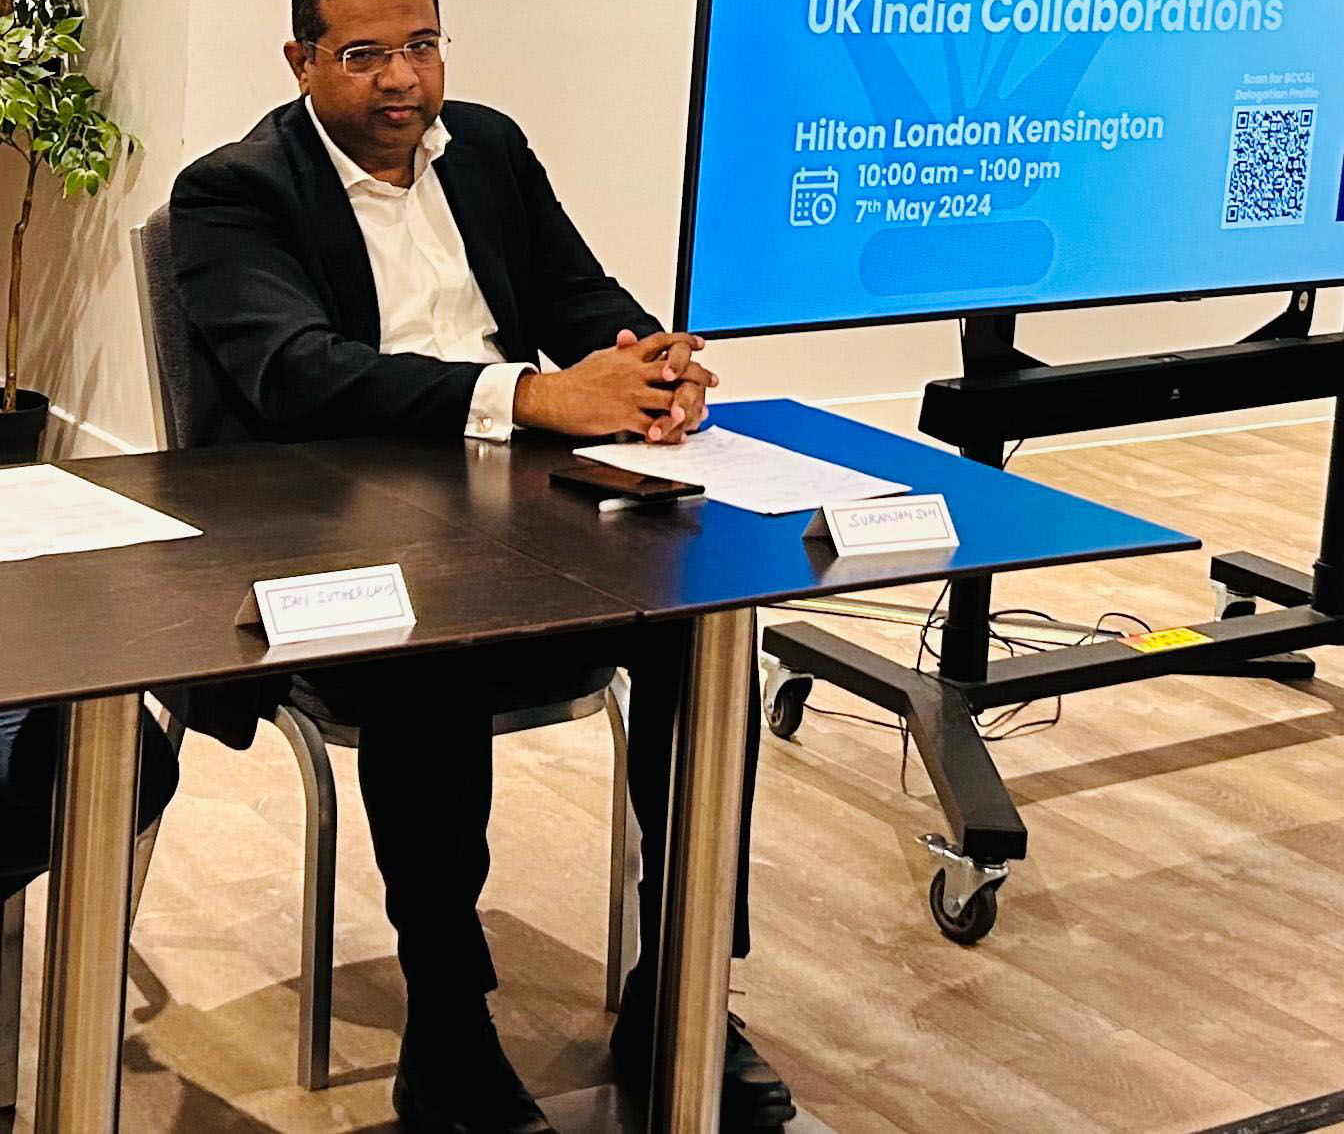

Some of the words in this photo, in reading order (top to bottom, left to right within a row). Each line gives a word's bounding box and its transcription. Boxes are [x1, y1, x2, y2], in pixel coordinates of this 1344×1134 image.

[1243, 73, 1268, 84] Scan
[1269, 72, 1283, 83] for
[1235, 89, 1288, 104] Delegation
[1289, 87, 1320, 99] Profile
[795, 117, 886, 151] Hilton
[893, 115, 1001, 148] London
[1007, 110, 1164, 150] Kensington
[859, 162, 916, 187] 10:00
[920, 165, 958, 185] am
[980, 158, 1021, 182] 1:00
[1024, 160, 1061, 187] pm
[856, 199, 881, 223] 7th
[886, 199, 934, 226] May
[939, 194, 991, 218] 2024
